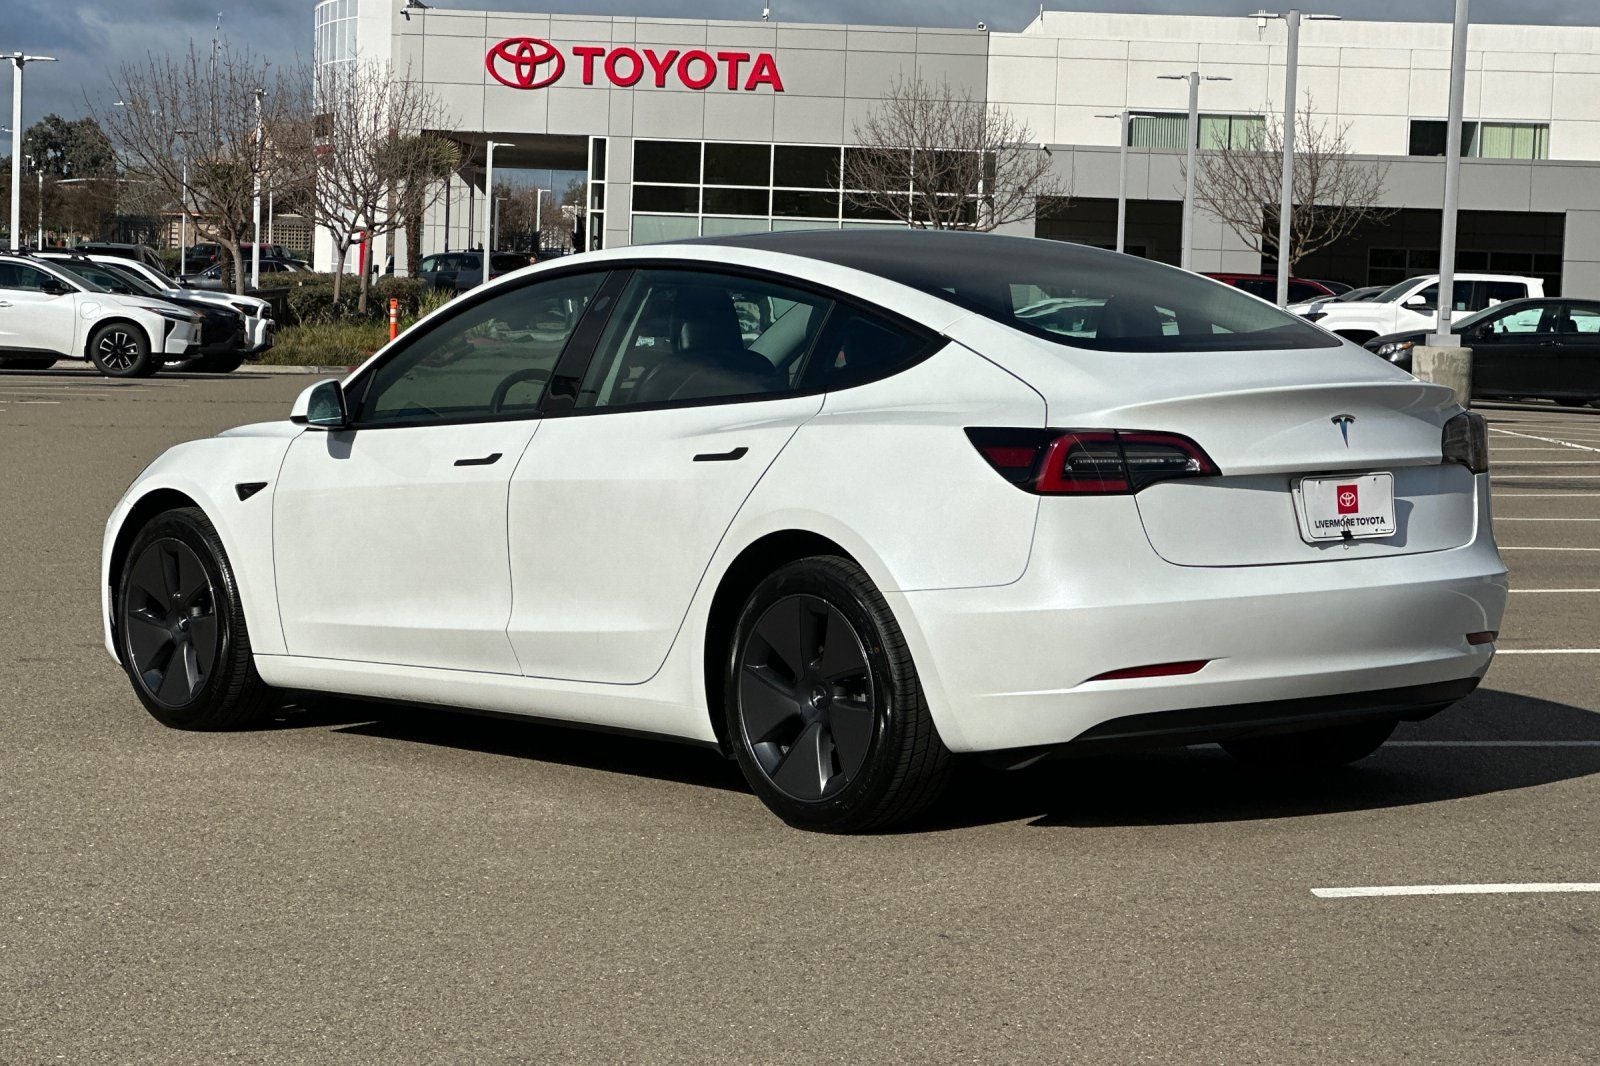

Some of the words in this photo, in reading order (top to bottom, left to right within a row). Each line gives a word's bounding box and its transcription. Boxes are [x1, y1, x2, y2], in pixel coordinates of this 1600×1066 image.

[572, 46, 784, 92] TOYOTA
[1314, 518, 1355, 528] LIVERMORE
[1356, 516, 1385, 526] TOYOTA
